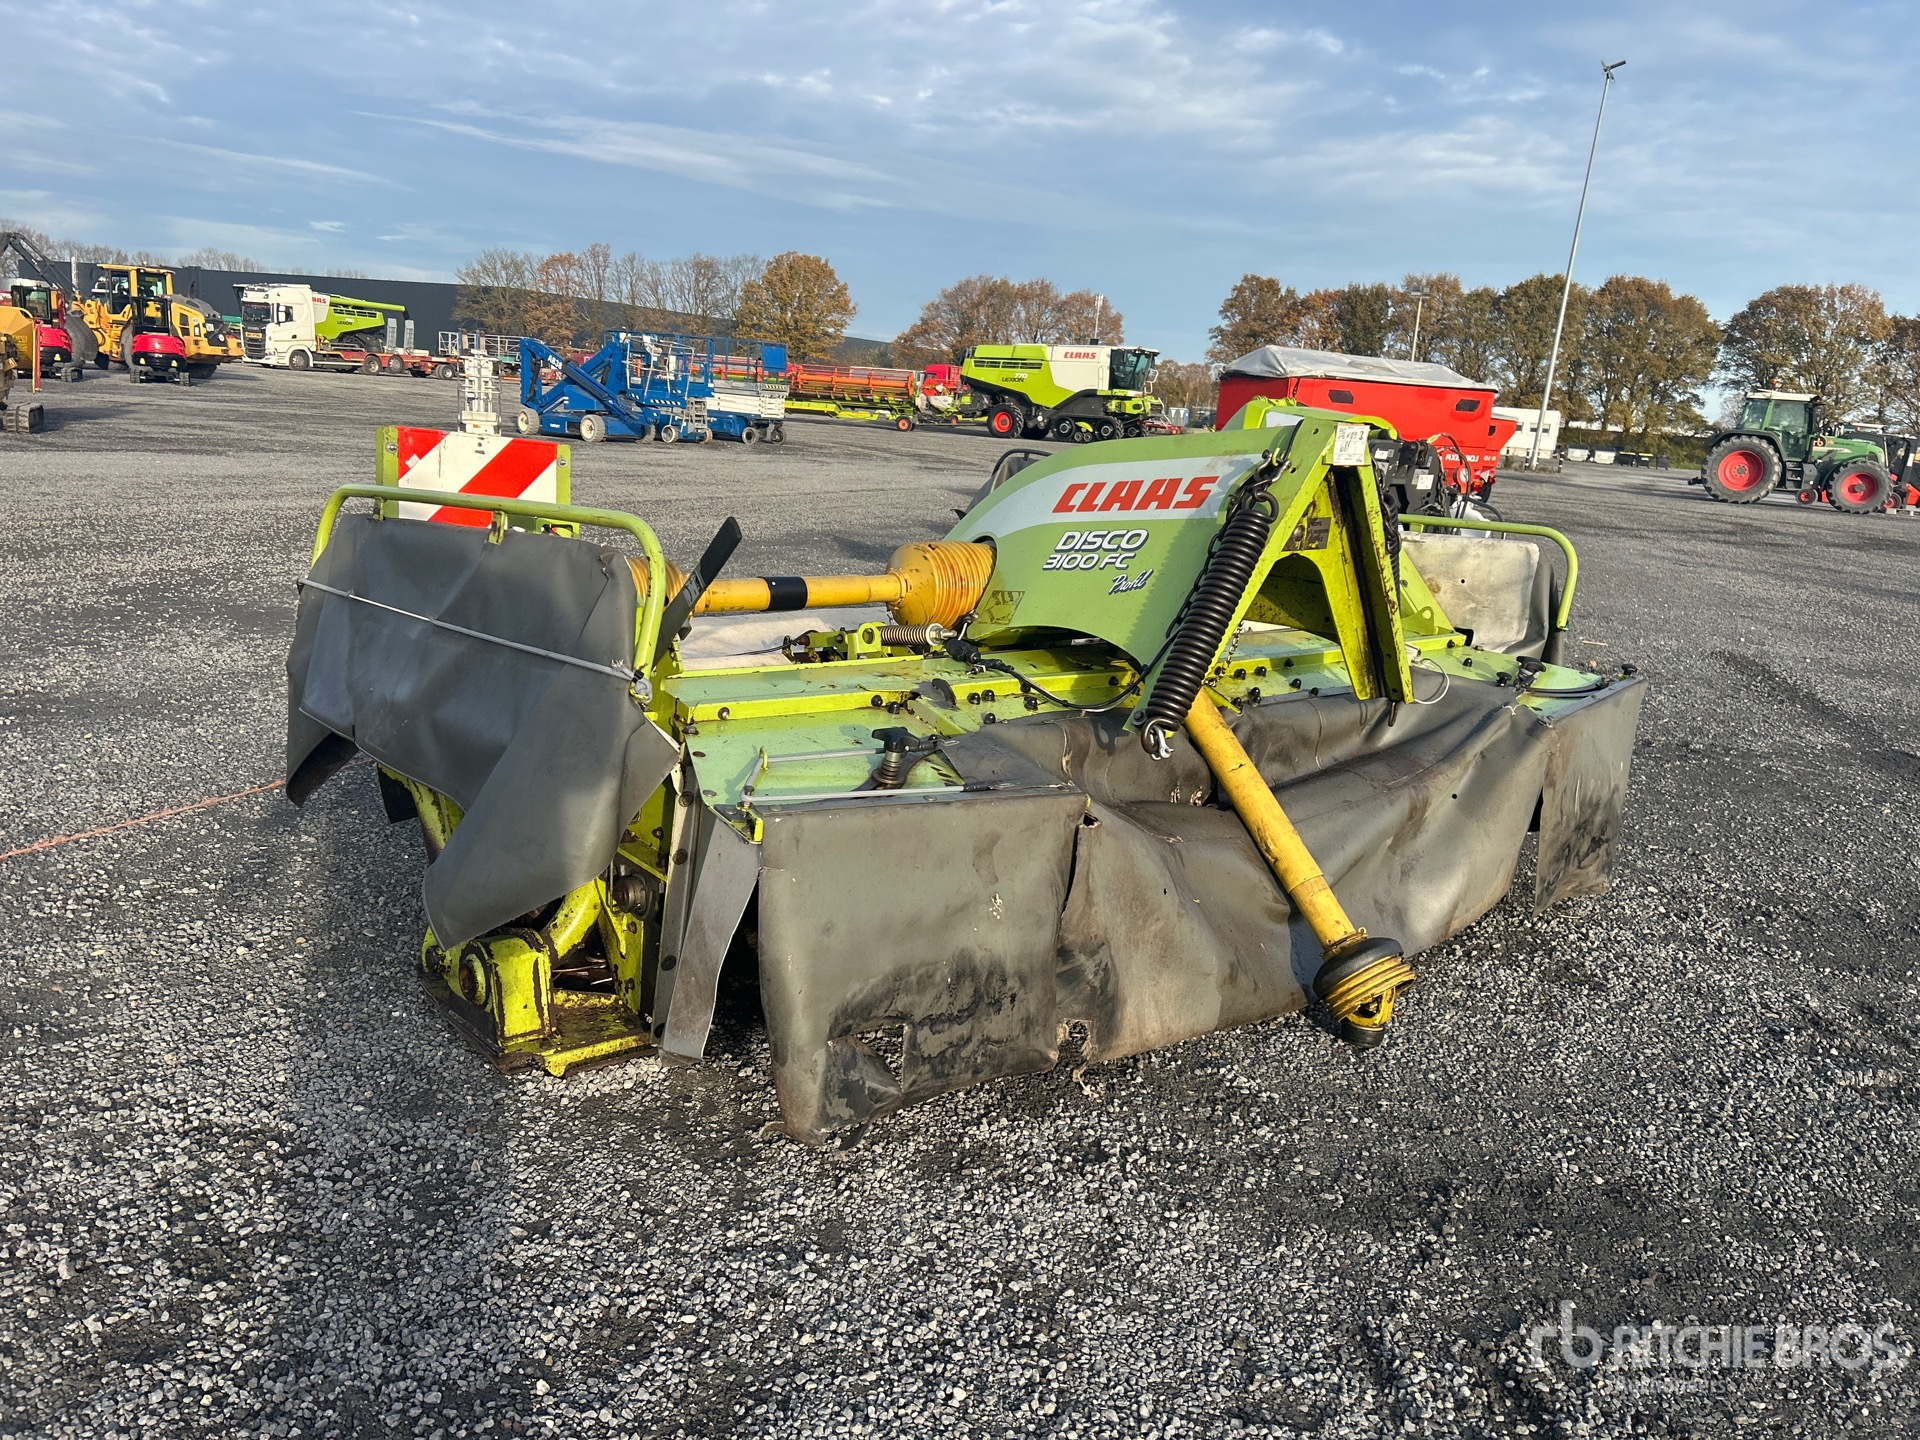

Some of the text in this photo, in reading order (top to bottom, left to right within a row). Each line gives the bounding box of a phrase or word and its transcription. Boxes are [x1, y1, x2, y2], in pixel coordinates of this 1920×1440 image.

[1063, 351, 1097, 360] CLAAS
[1052, 475, 1220, 514] CLAAS
[1055, 528, 1150, 552] DISCO
[1042, 552, 1137, 571] 3100 FC
[1108, 568, 1155, 595] Profil
